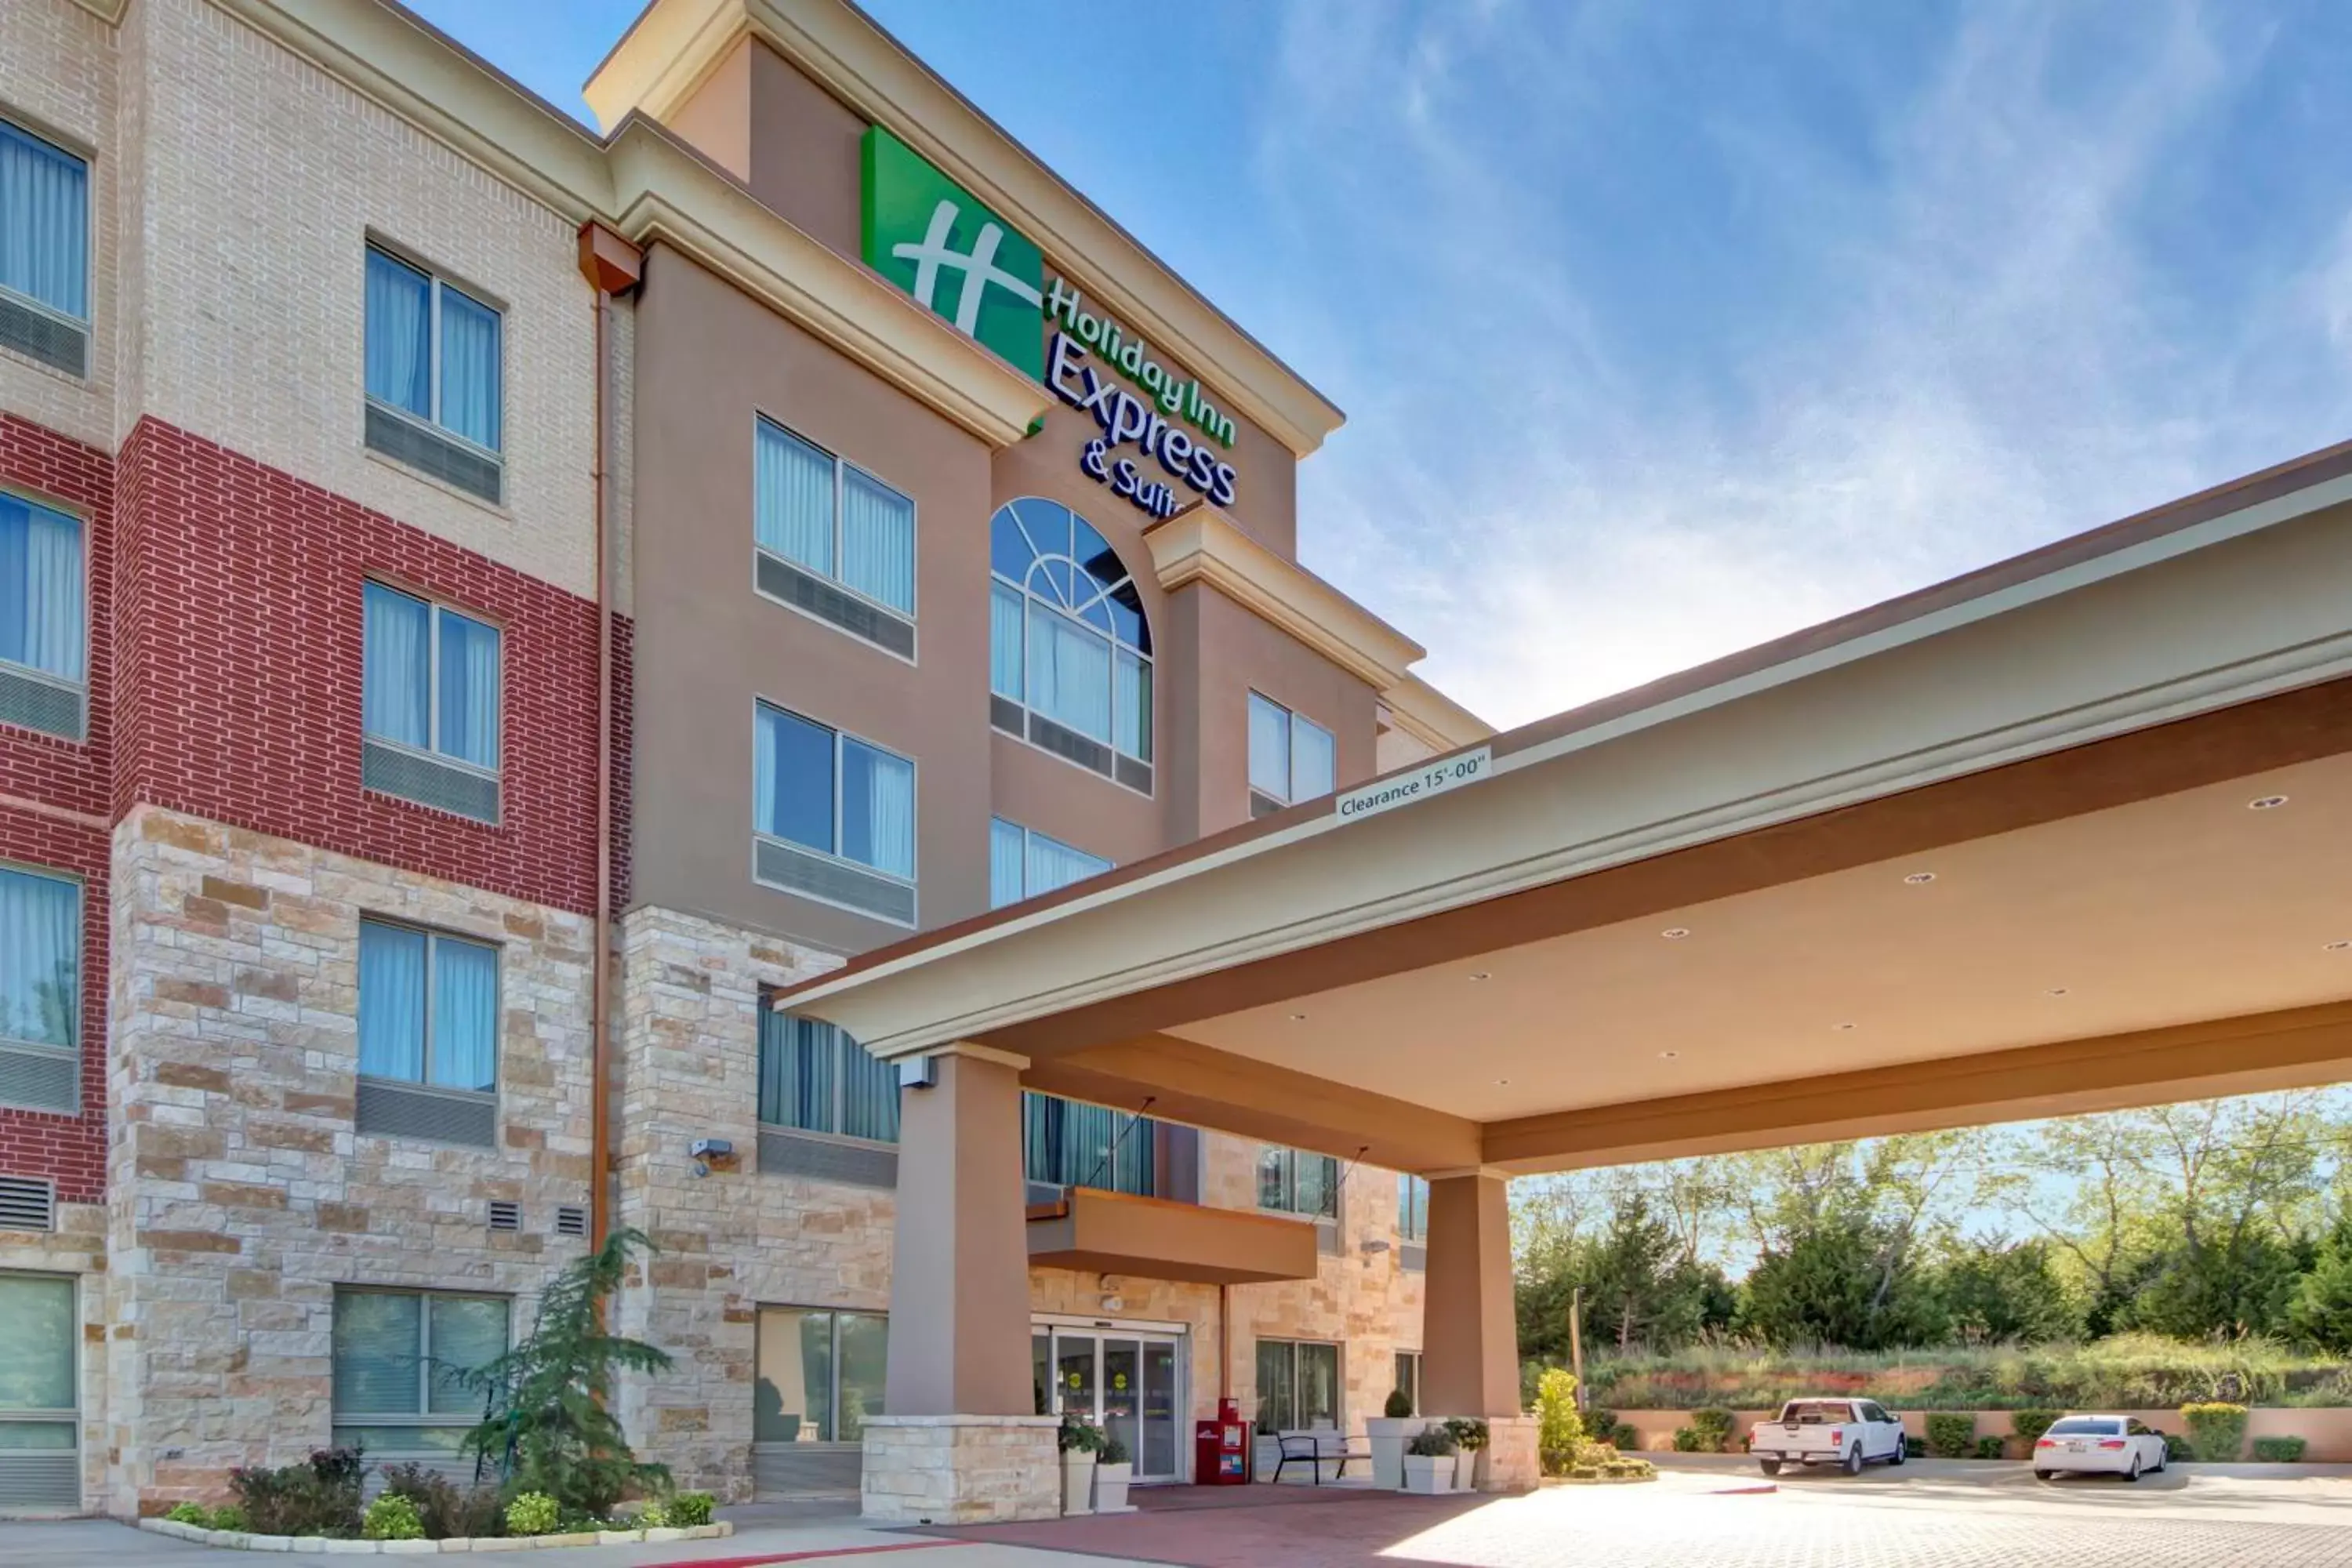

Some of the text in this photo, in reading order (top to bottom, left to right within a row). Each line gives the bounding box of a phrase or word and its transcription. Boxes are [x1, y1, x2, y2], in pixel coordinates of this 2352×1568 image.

[1045, 276, 1236, 448] Holiday Inn
[1047, 331, 1237, 506] Express
[1083, 438, 1185, 518] & Suit
[1341, 753, 1486, 816] Clearance 15'-00"
